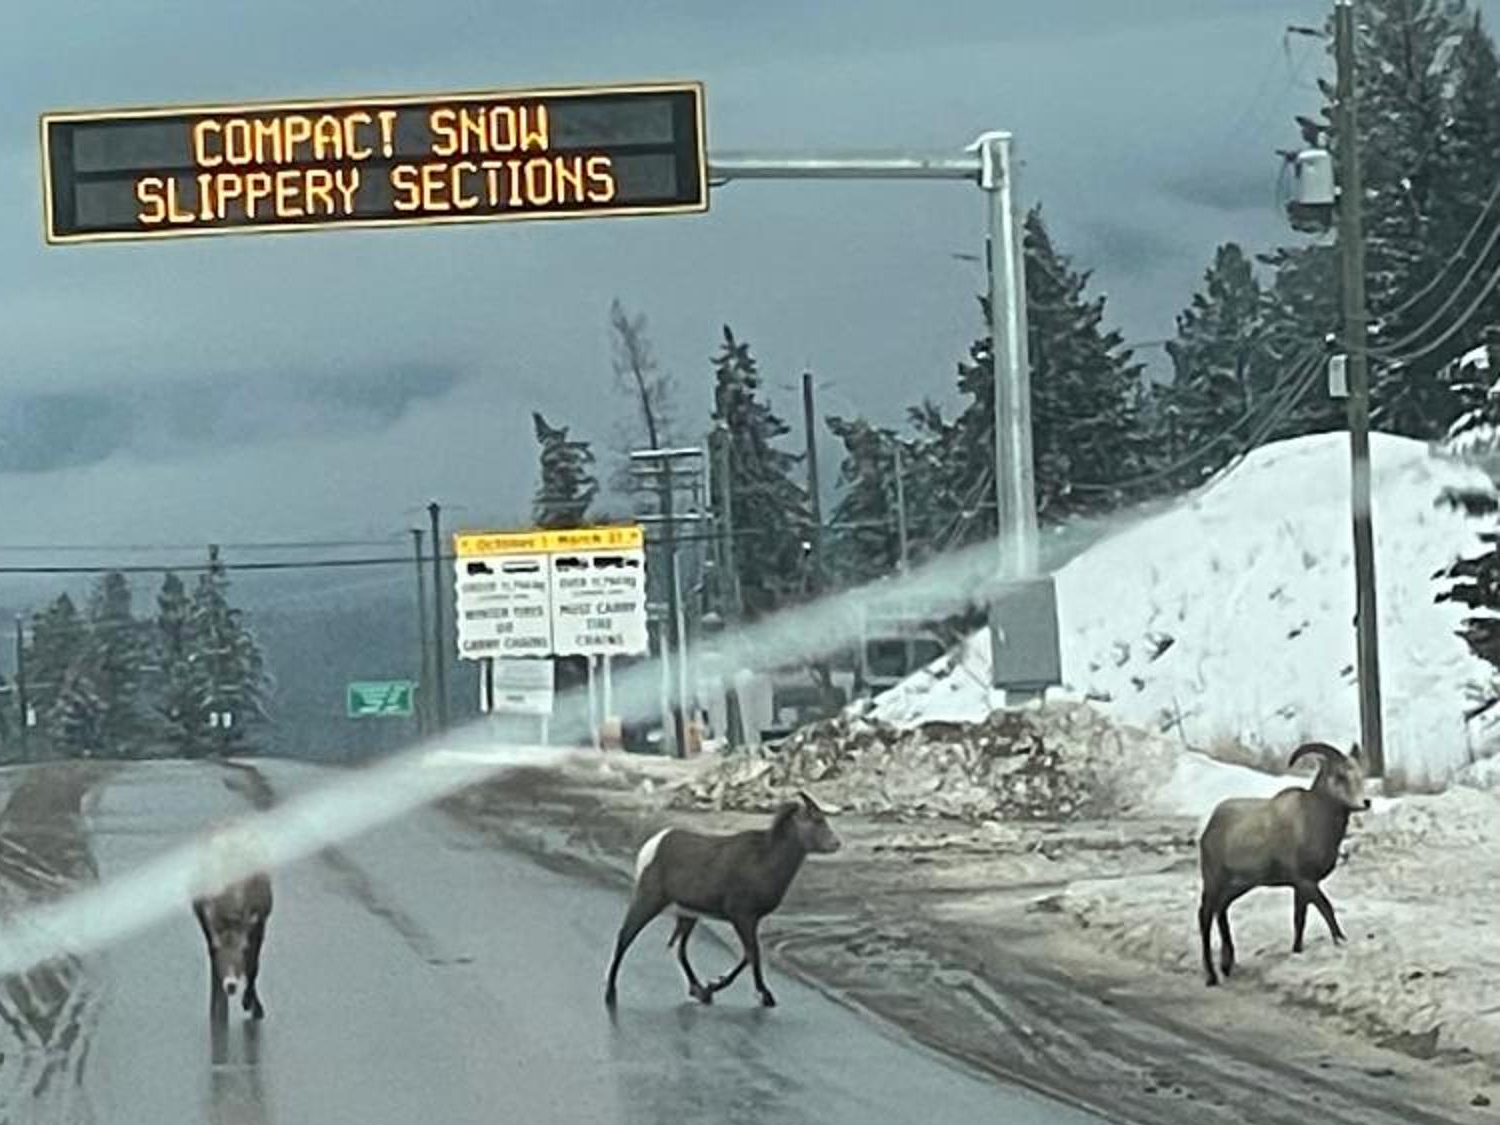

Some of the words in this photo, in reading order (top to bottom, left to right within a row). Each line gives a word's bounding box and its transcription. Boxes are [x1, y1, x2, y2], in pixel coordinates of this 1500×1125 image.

[195, 110, 397, 167] COMPACT
[431, 104, 549, 156] SNOW
[136, 167, 360, 224] SLIPPERY
[392, 156, 616, 211] SECTIONS
